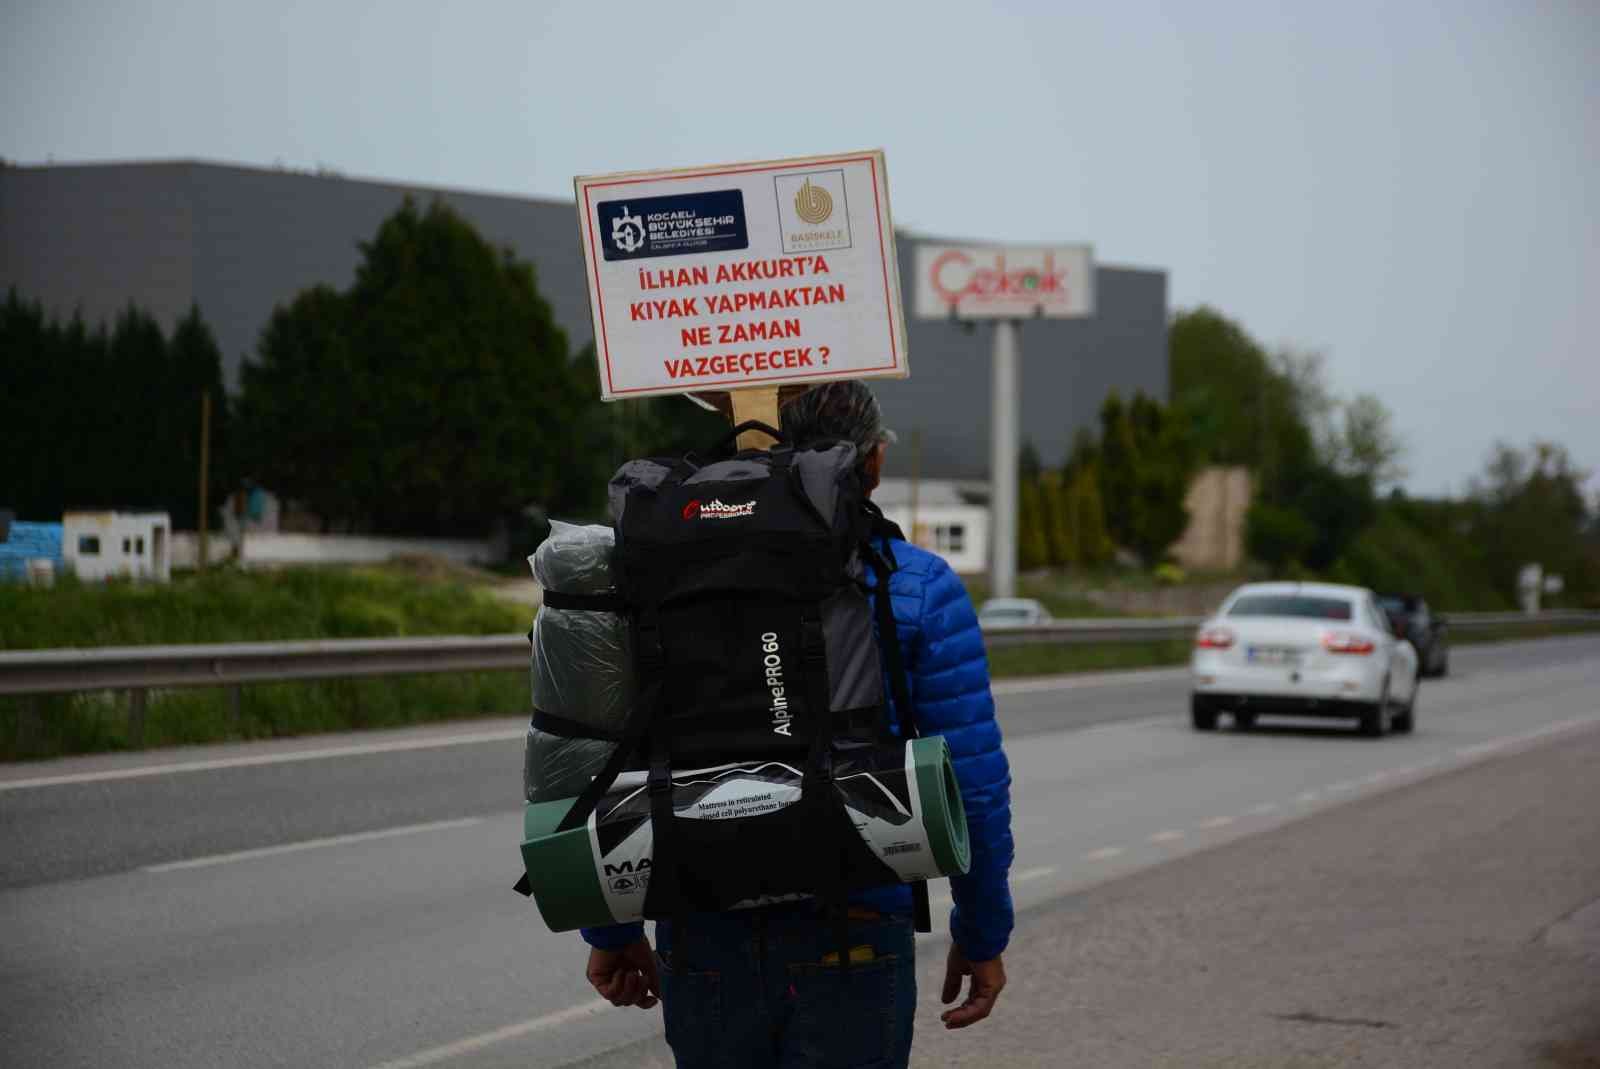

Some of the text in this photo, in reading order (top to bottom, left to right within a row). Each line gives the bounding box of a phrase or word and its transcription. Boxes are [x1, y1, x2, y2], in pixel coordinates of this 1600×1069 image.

[647, 209, 696, 222] KOCAELİ
[639, 267, 709, 290] İLHAN
[630, 284, 846, 321] KIYAK YAPMAKTAN
[681, 319, 801, 347] NE ZAMAN
[664, 346, 831, 379] VAZGEÇECEK ?
[699, 802, 727, 810] Mattress
